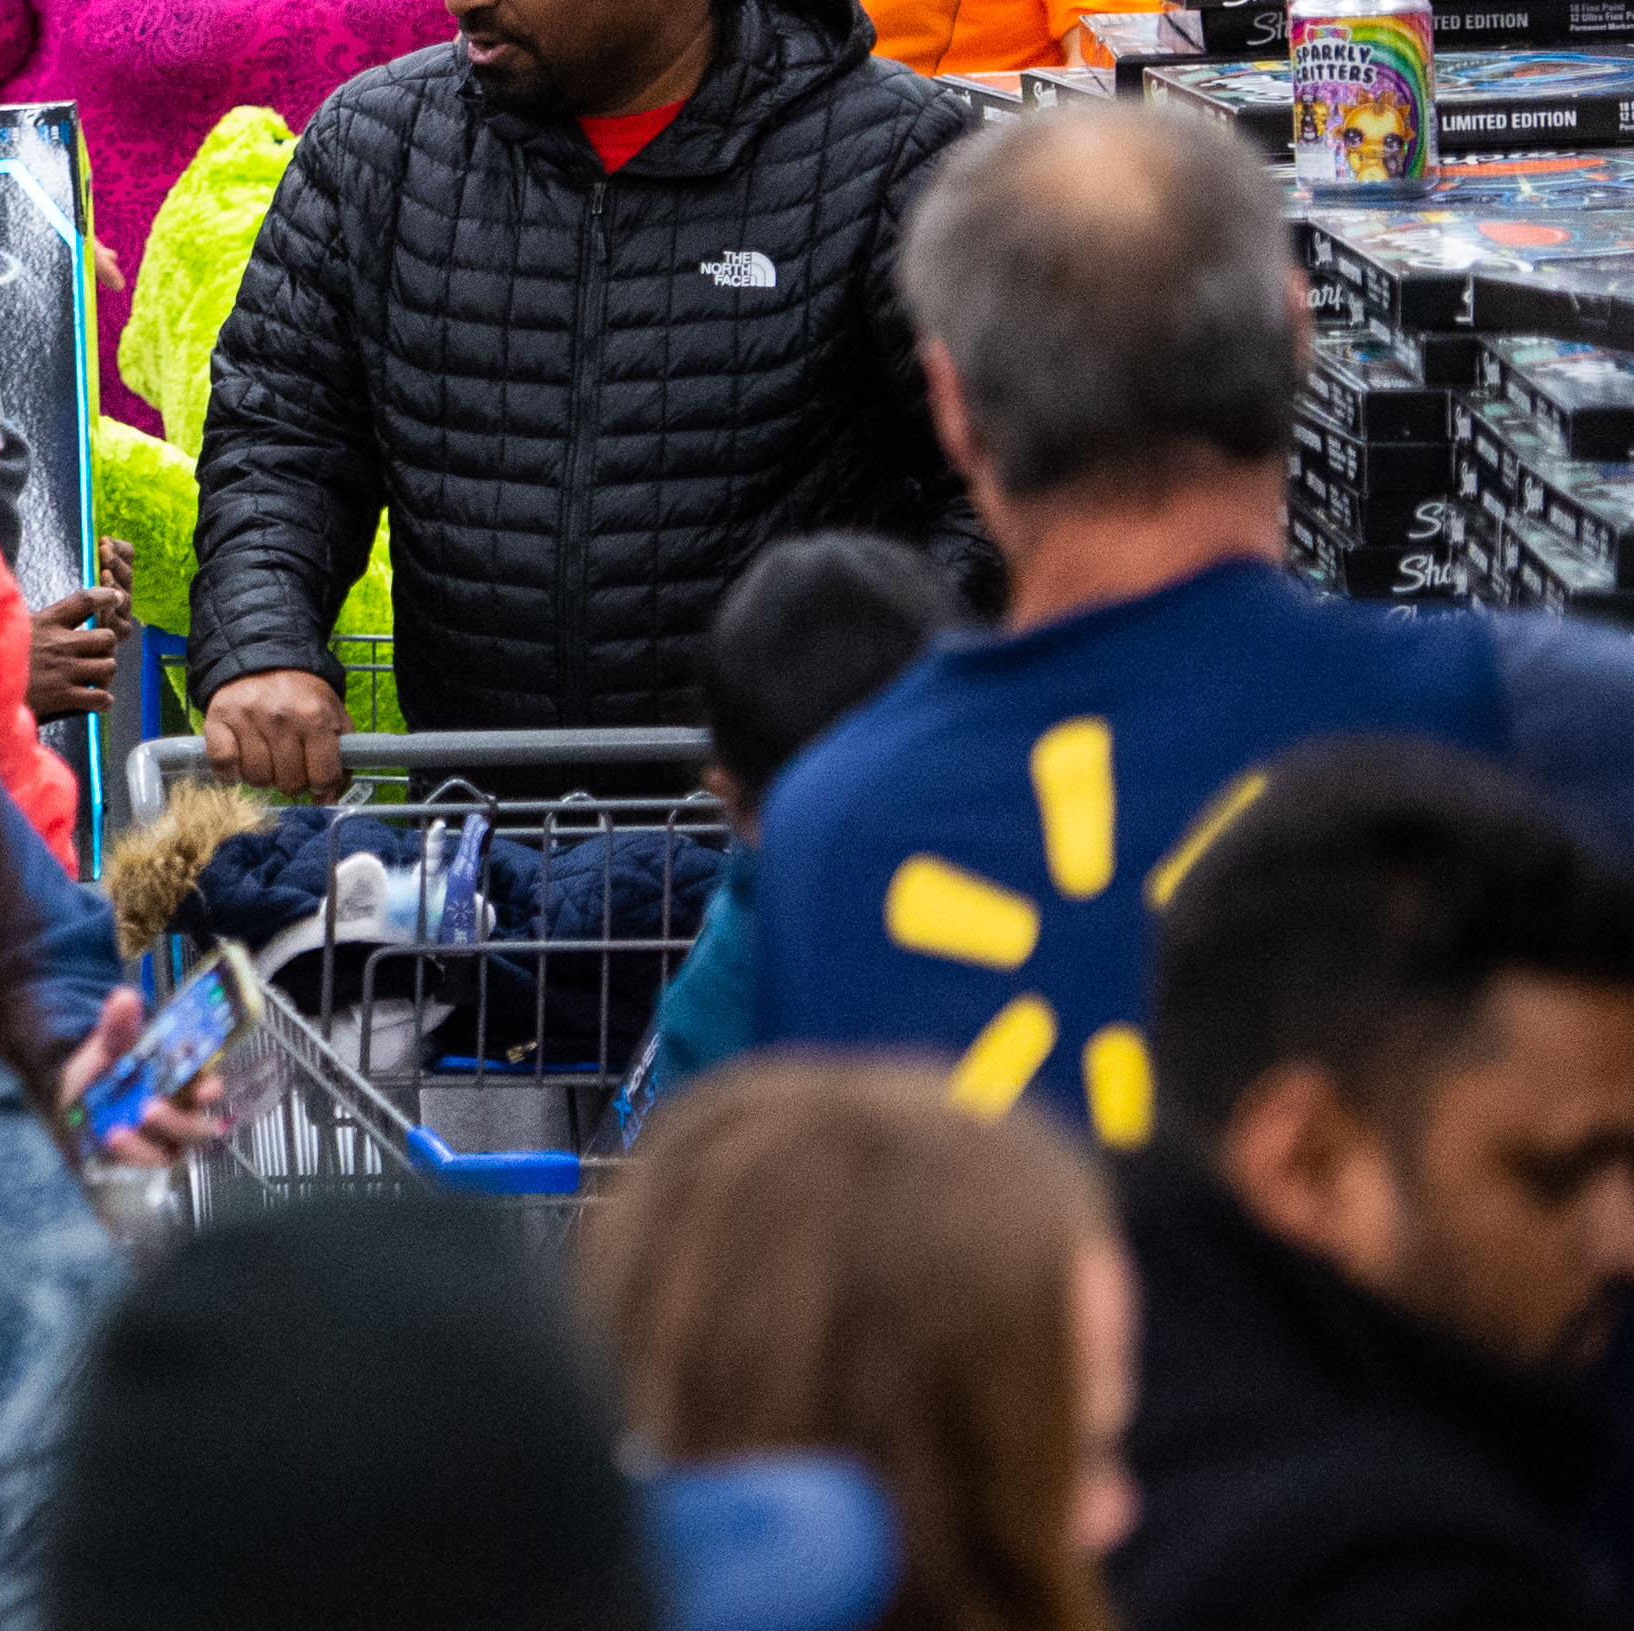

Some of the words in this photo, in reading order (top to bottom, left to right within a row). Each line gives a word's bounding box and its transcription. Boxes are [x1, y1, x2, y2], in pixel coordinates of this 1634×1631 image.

[1464, 13, 1529, 29] EDITION
[1295, 43, 1372, 66] SPARKLY
[1295, 64, 1375, 85] CRITTERS
[1443, 115, 1507, 131] LIMITED
[1512, 112, 1577, 129] EDITION
[723, 250, 752, 264] THE
[700, 262, 751, 276] NORTH
[715, 274, 750, 287] FACE
